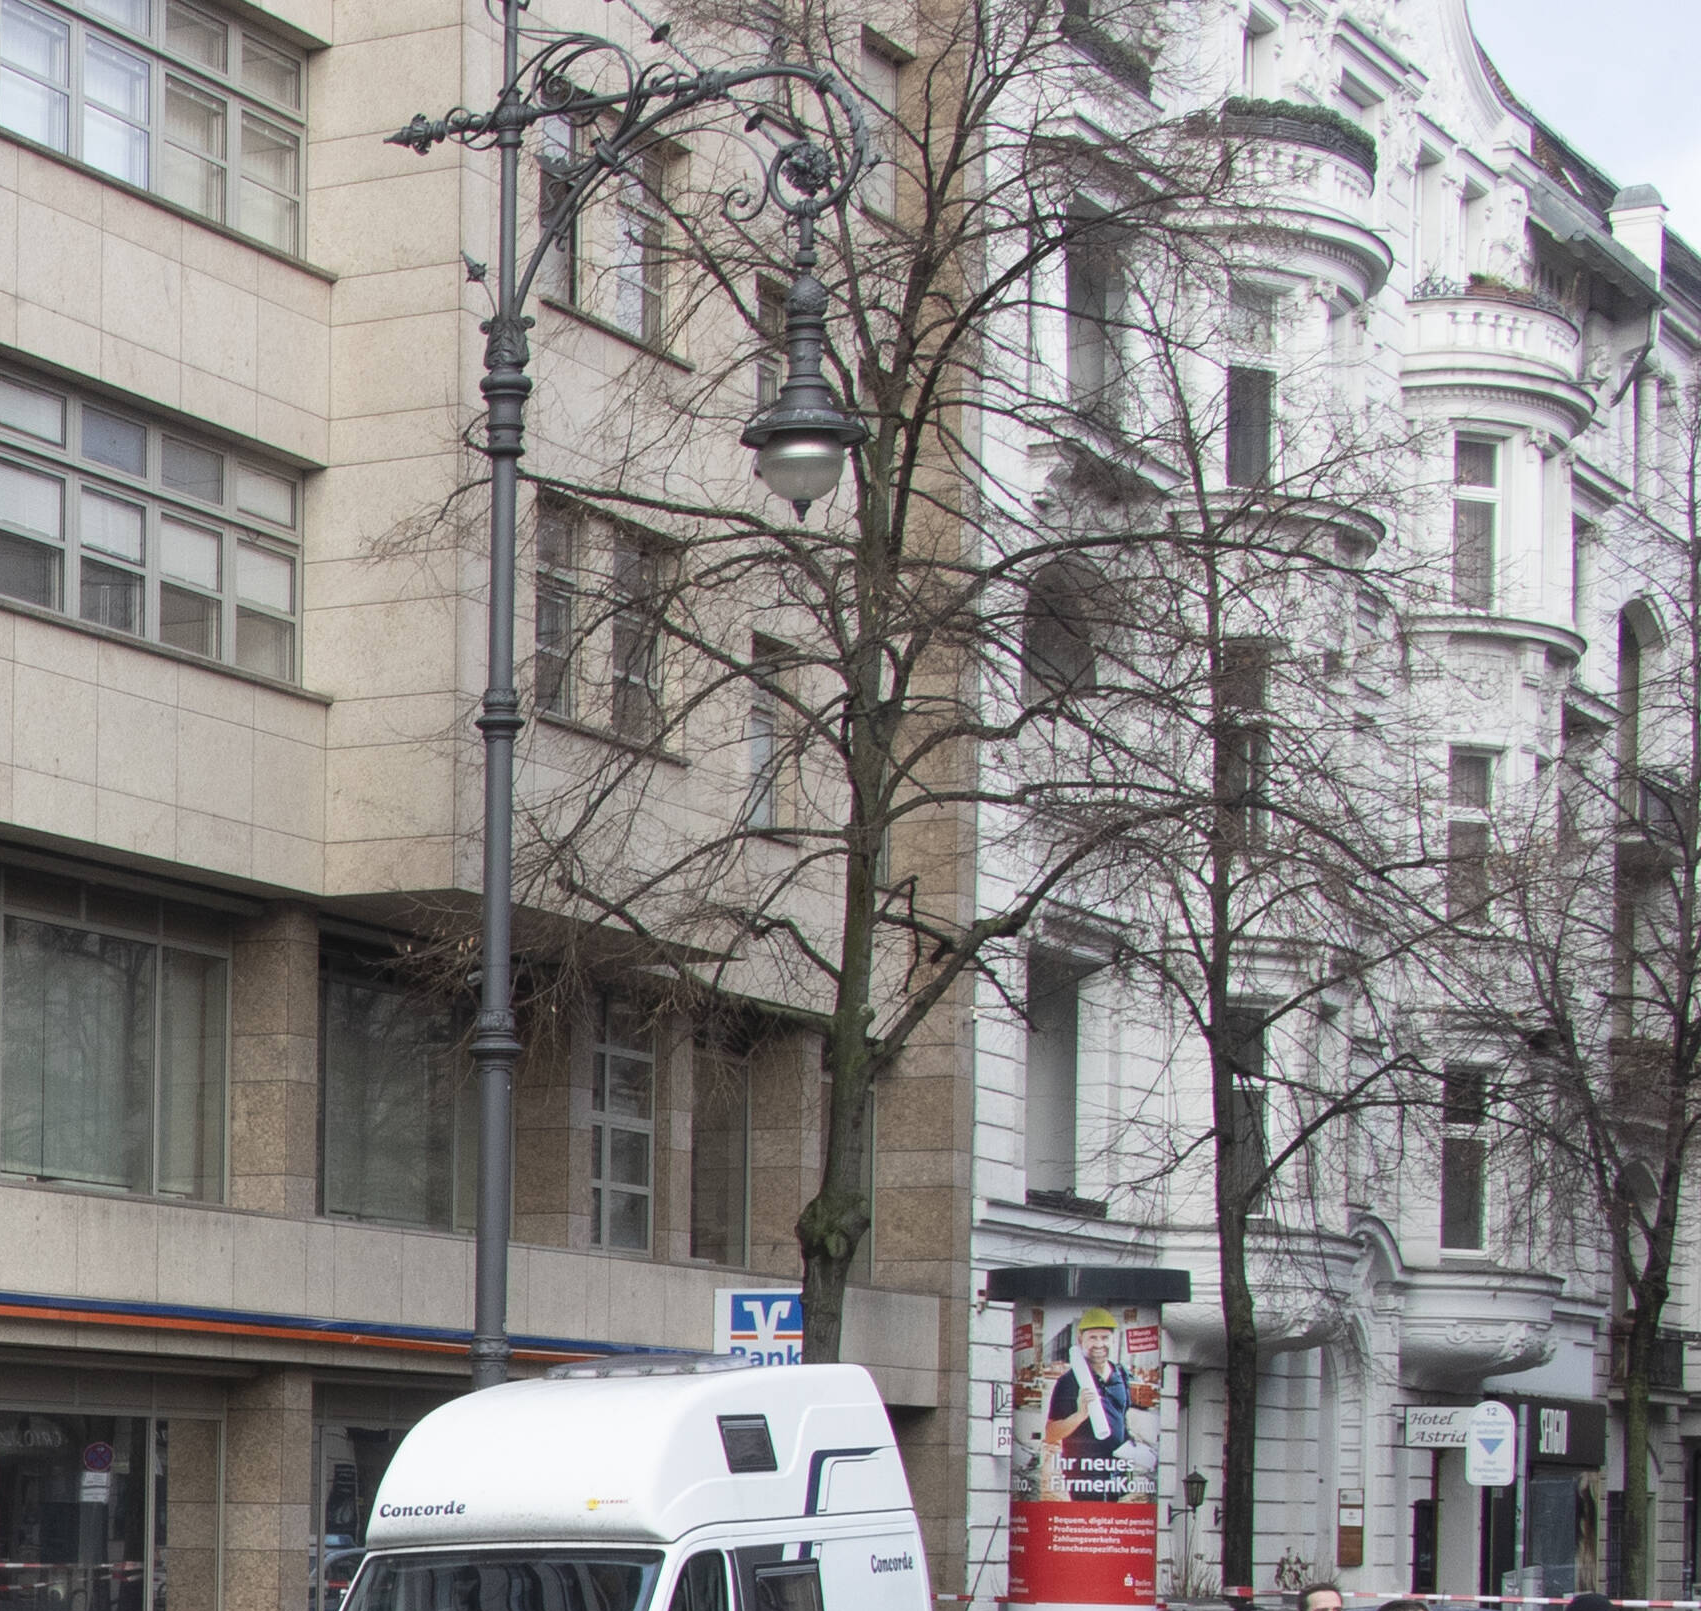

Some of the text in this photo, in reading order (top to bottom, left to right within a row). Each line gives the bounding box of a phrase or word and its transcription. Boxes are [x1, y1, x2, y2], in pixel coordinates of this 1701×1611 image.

[1409, 1411, 1459, 1426] Hotel
[1485, 1407, 1497, 1416] 12
[1409, 1430, 1469, 1444] Astrid
[1051, 1453, 1134, 1472] Ihr neues
[379, 1500, 466, 1518] Concorde
[870, 1551, 914, 1574] Concorde
